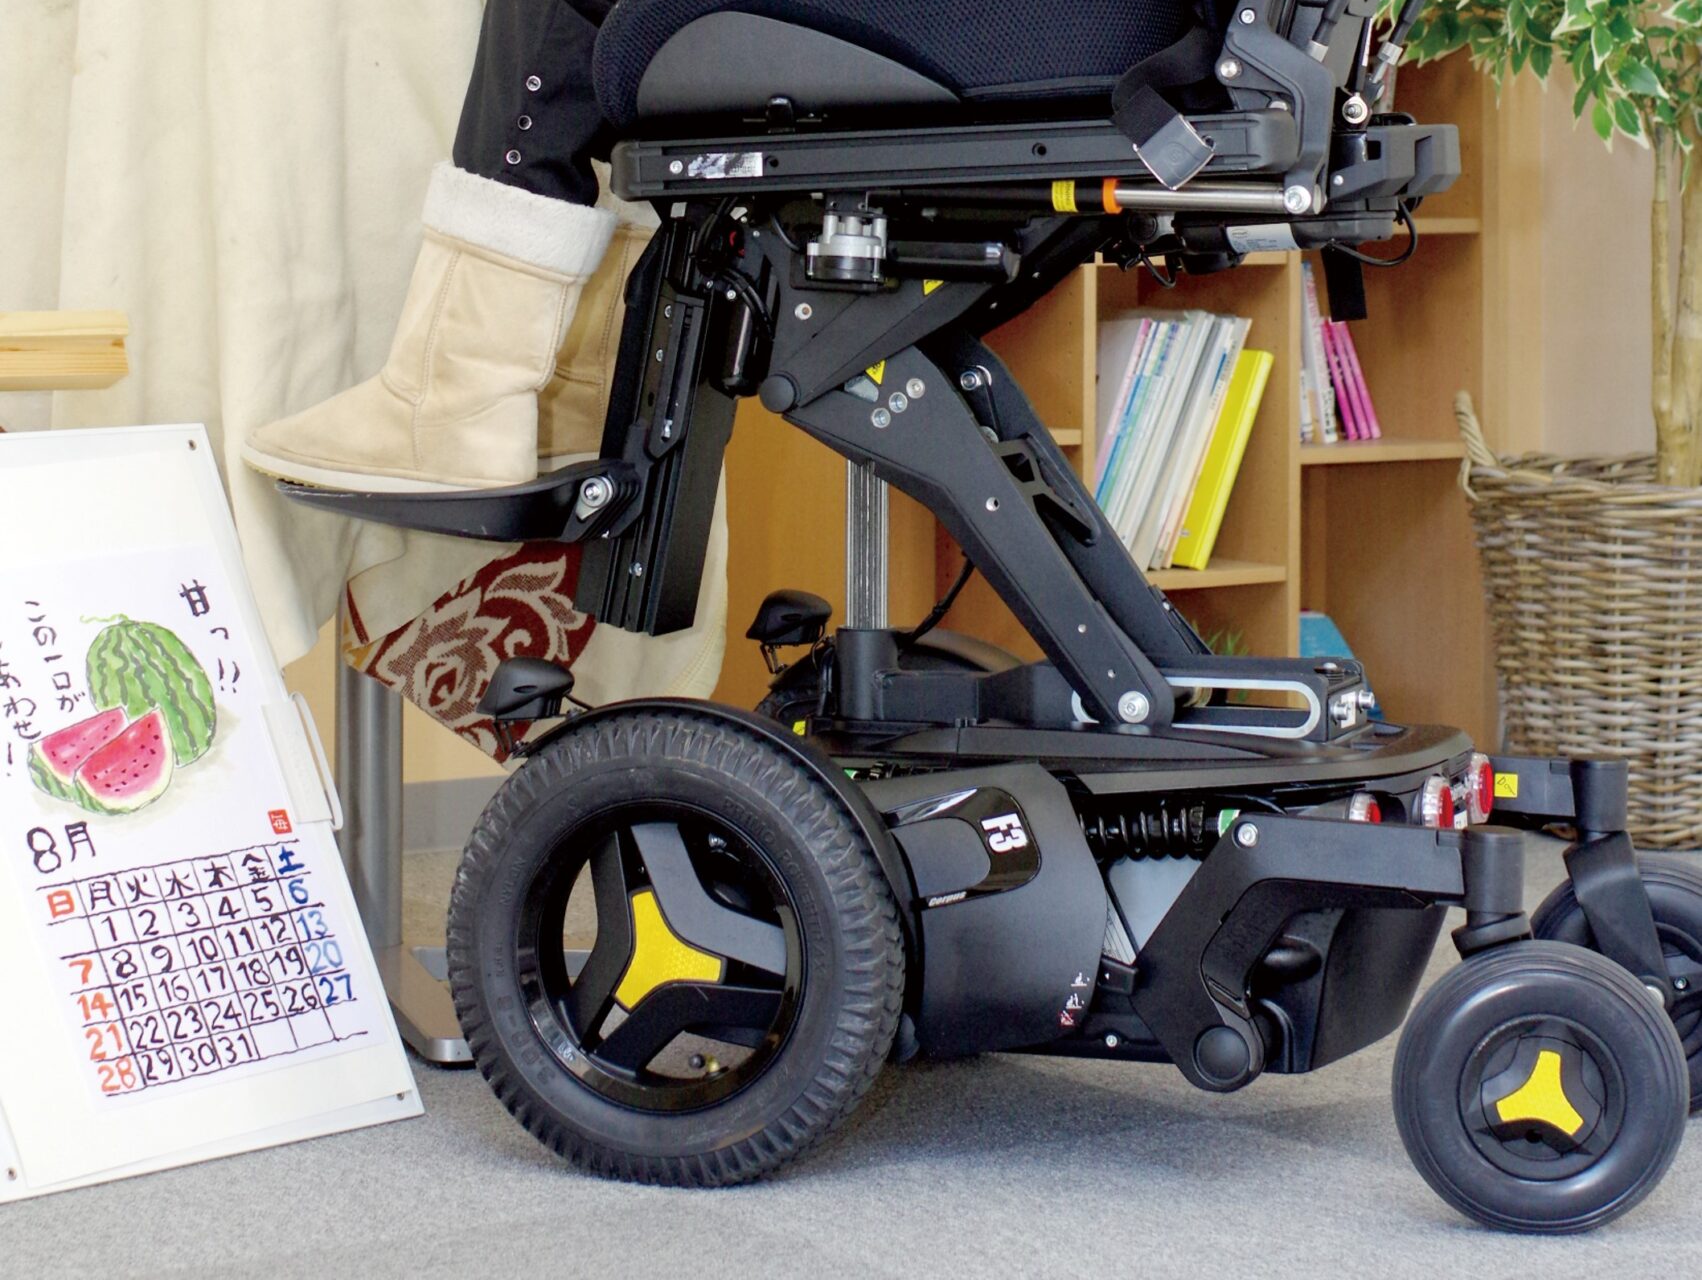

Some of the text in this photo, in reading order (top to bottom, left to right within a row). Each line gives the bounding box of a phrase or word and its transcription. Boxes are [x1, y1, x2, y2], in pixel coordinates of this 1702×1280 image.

[25, 600, 86, 713] この一口が
[26, 822, 96, 873] 8月
[980, 812, 1029, 853] F3
[47, 847, 305, 918] 日 月 火 水 木 金 土
[102, 879, 309, 942] 1 2 3 4 5 6
[69, 911, 328, 984] 7 8 9 10 11 12 13
[77, 943, 344, 1020] 14 15 16 17 18 19 20
[85, 974, 353, 1060] 21 22 23 24 25 26 27
[98, 1034, 248, 1092] 28 29 30 31
